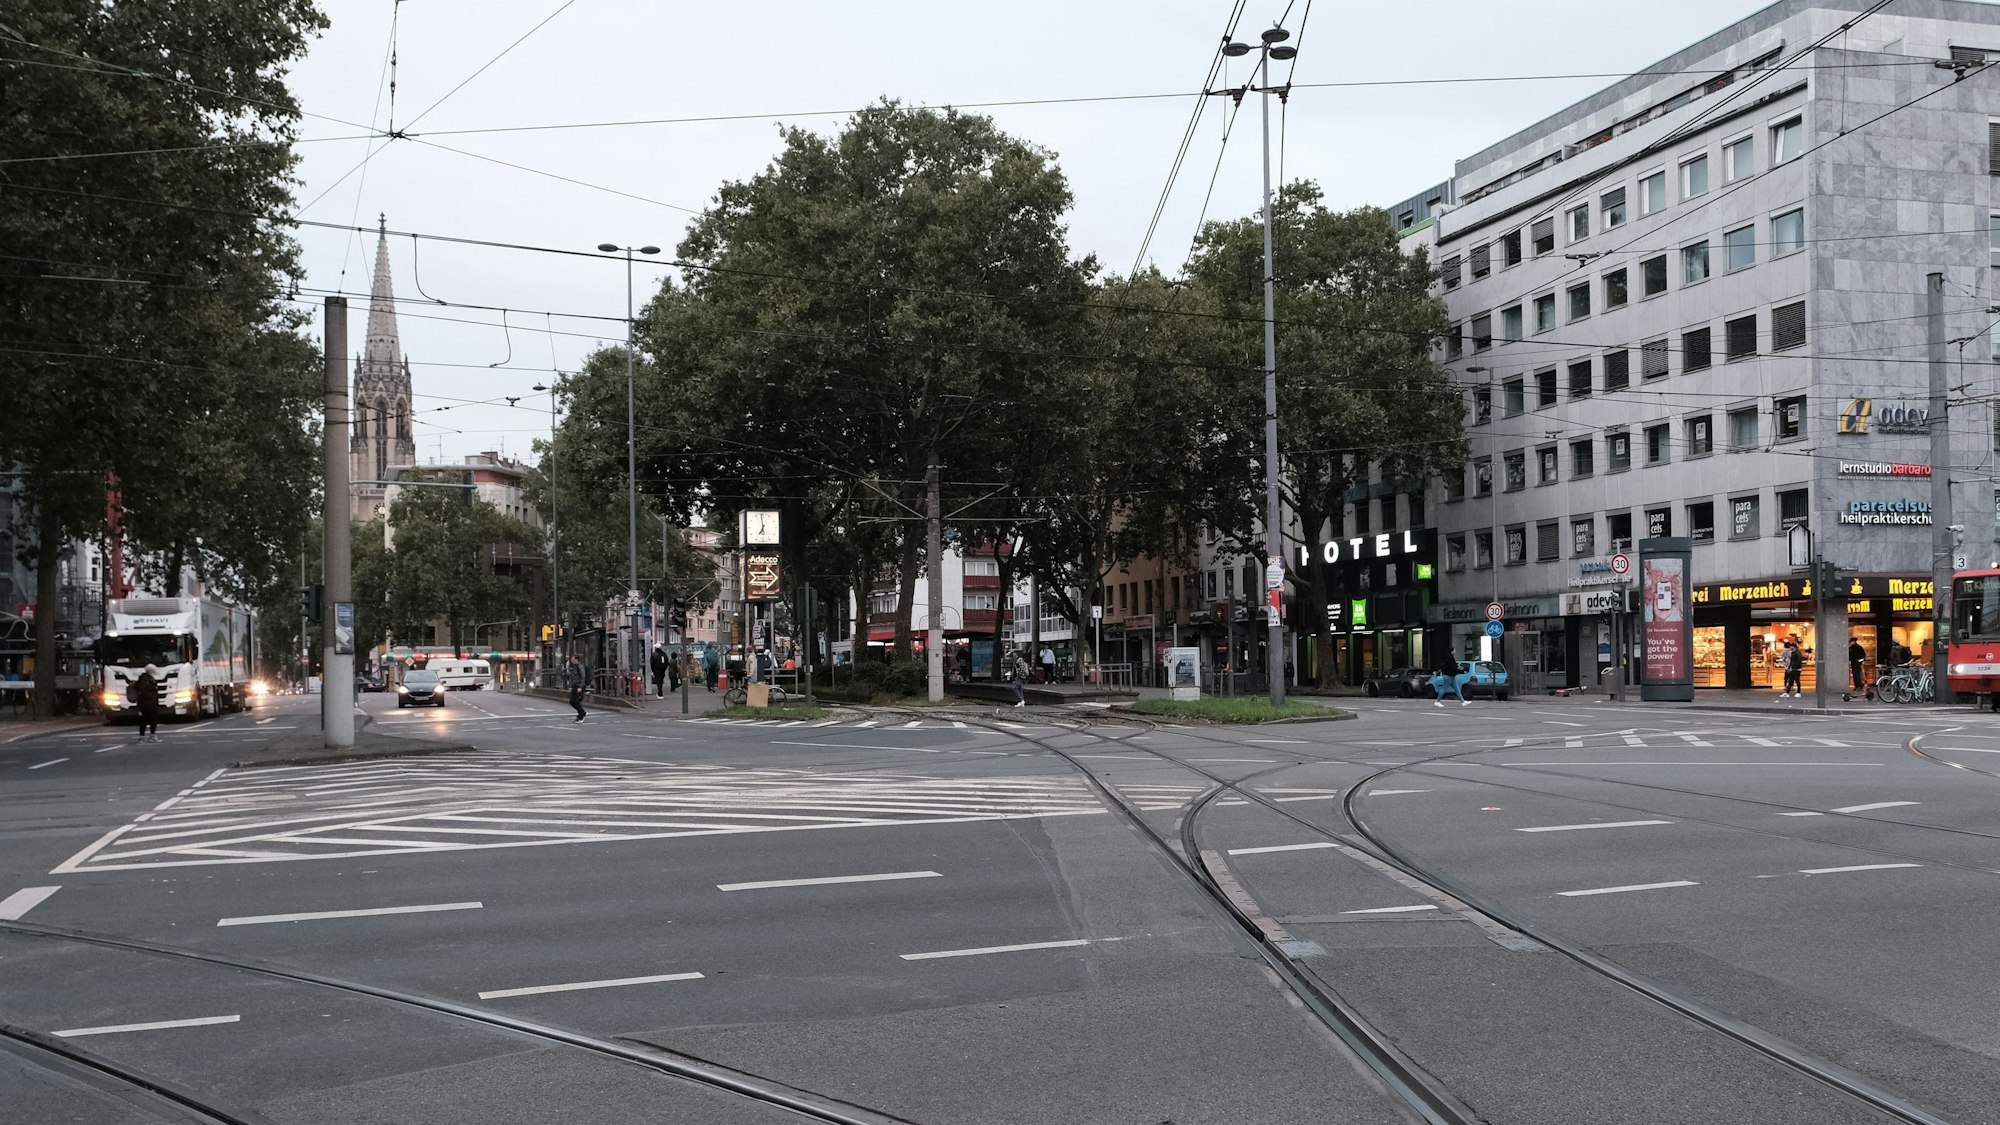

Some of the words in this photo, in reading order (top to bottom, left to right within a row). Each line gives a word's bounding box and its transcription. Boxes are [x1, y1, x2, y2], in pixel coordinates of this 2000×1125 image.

[750, 555, 778, 563] Adecco
[1958, 557, 1965, 568] 3
[1615, 559, 1626, 569] 30
[1720, 582, 1789, 601] Merzenich
[1489, 607, 1500, 616] 30
[1647, 645, 1660, 654] got
[1647, 653, 1674, 661] power
